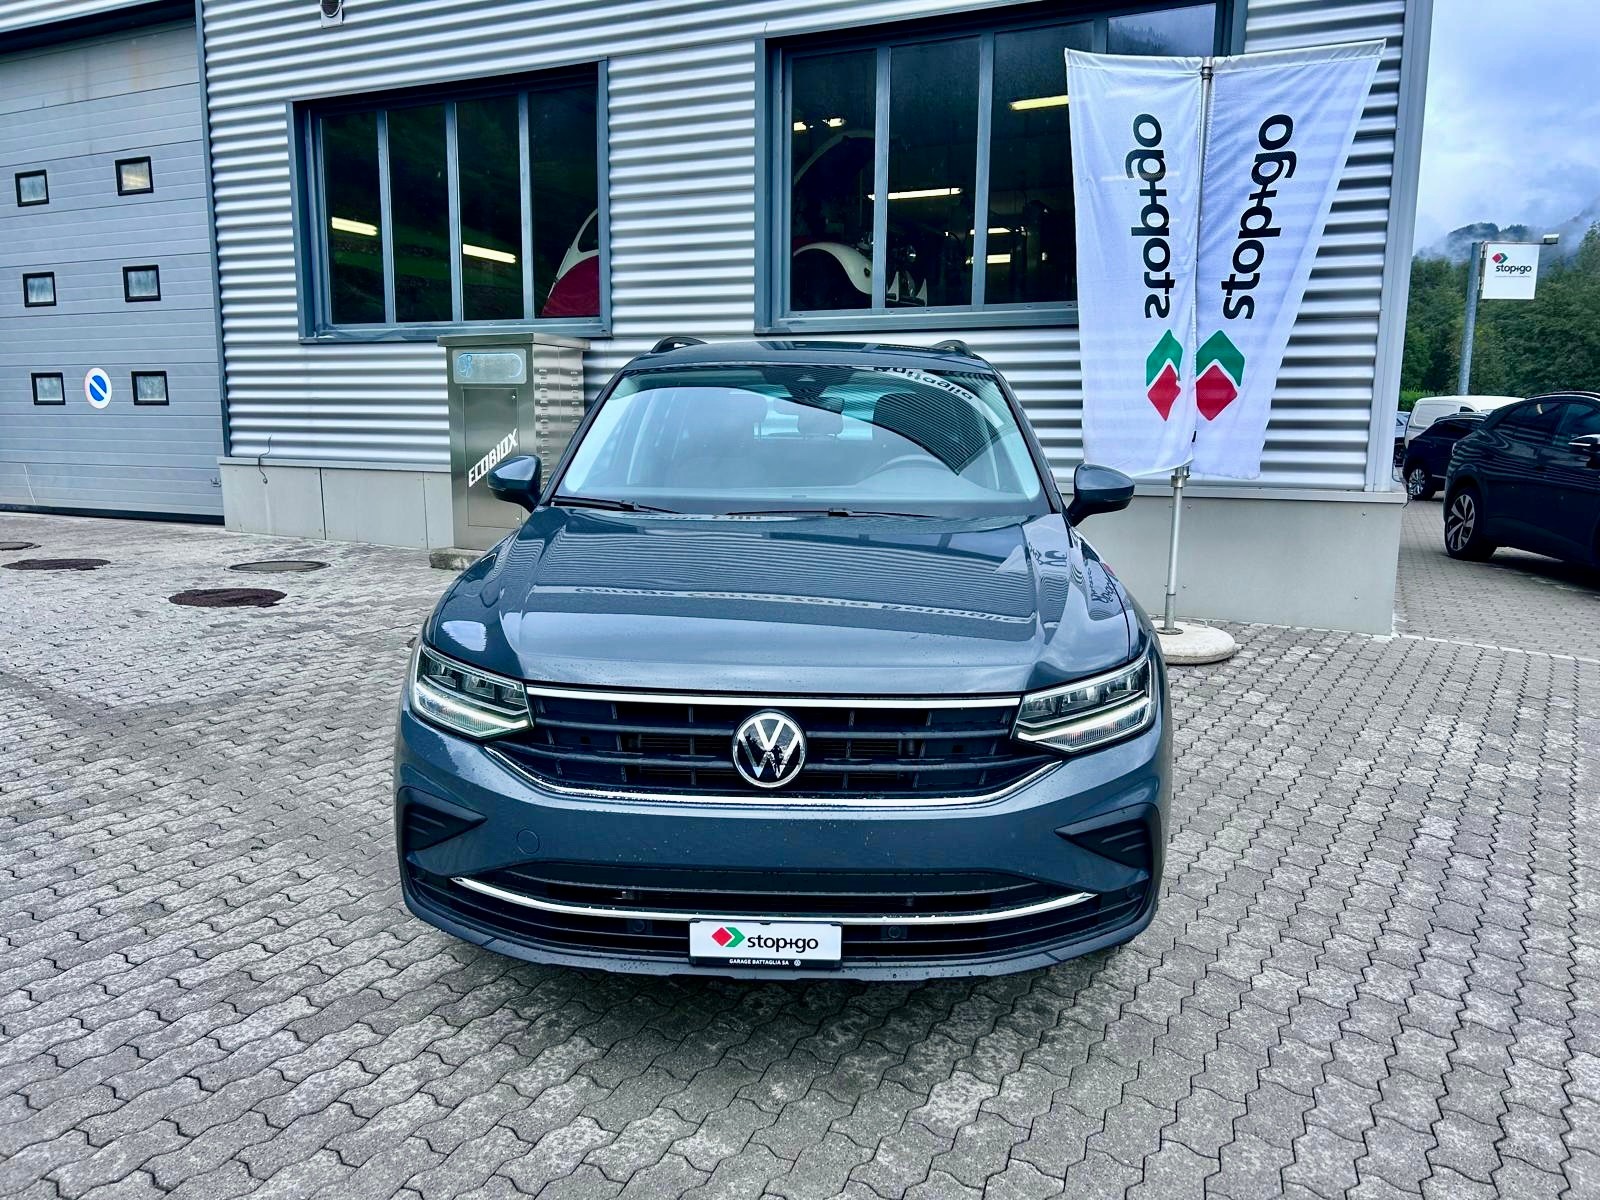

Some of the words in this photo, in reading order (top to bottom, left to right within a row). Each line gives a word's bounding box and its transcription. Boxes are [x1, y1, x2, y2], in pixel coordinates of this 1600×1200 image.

[1220, 113, 1297, 321] stop+go
[1495, 264, 1532, 274] stop+go
[737, 715, 802, 781] VW
[747, 934, 818, 953] stop+go
